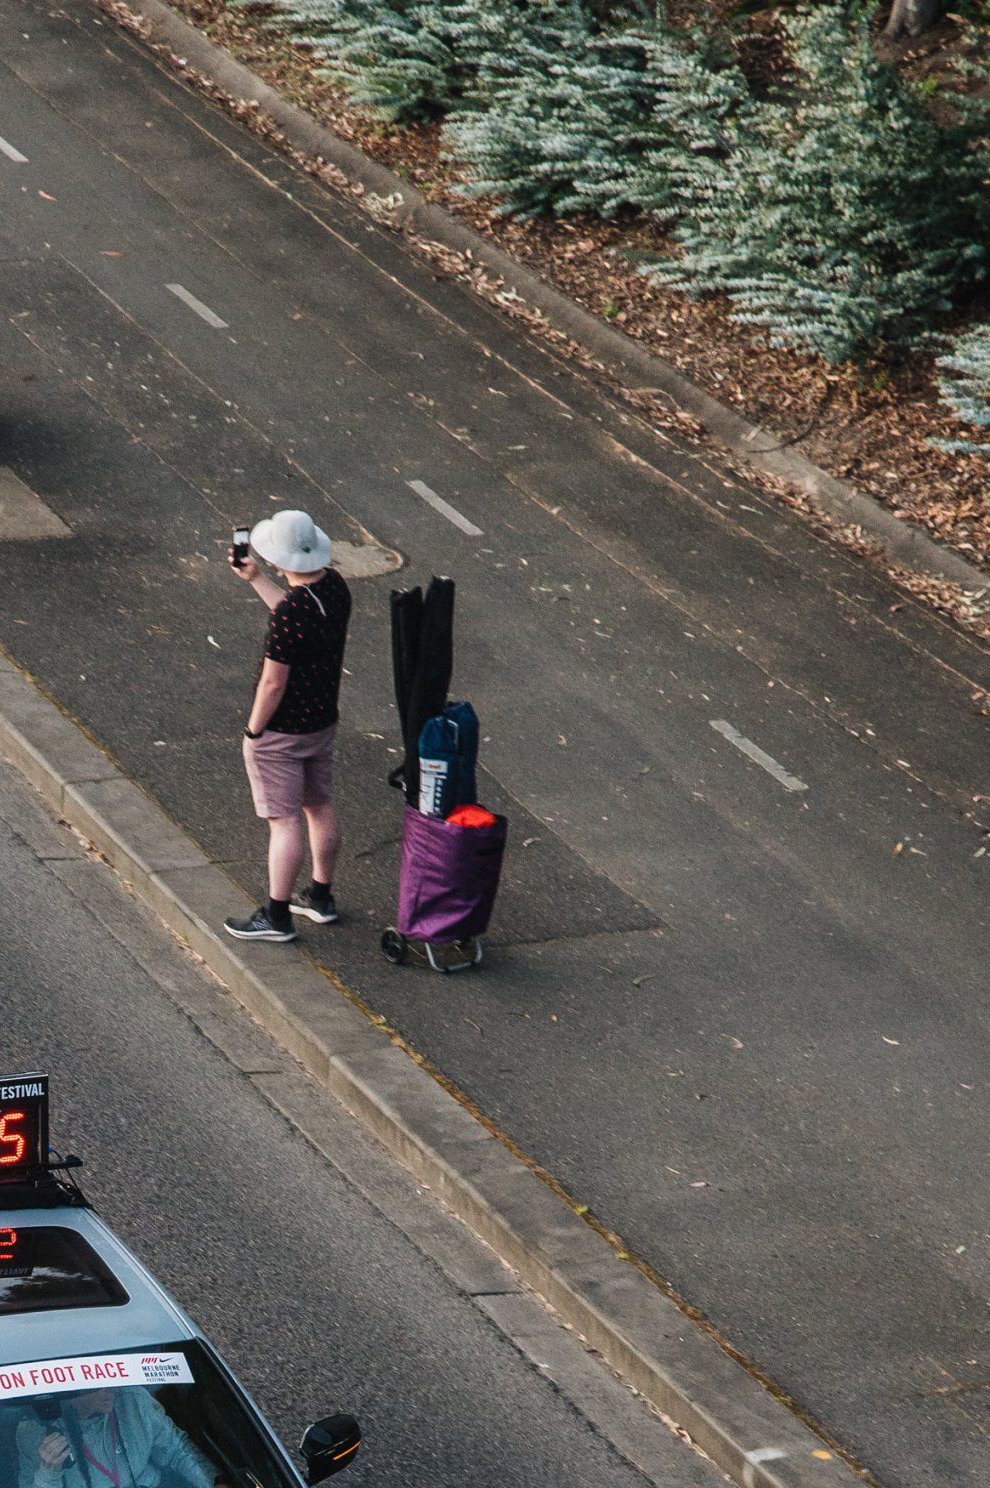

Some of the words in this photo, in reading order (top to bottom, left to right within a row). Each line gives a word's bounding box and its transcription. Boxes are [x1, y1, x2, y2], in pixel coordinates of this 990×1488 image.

[30, 1366, 75, 1386] FOOT
[81, 1361, 130, 1381] RACE
[141, 1364, 180, 1372] MELBOURNE
